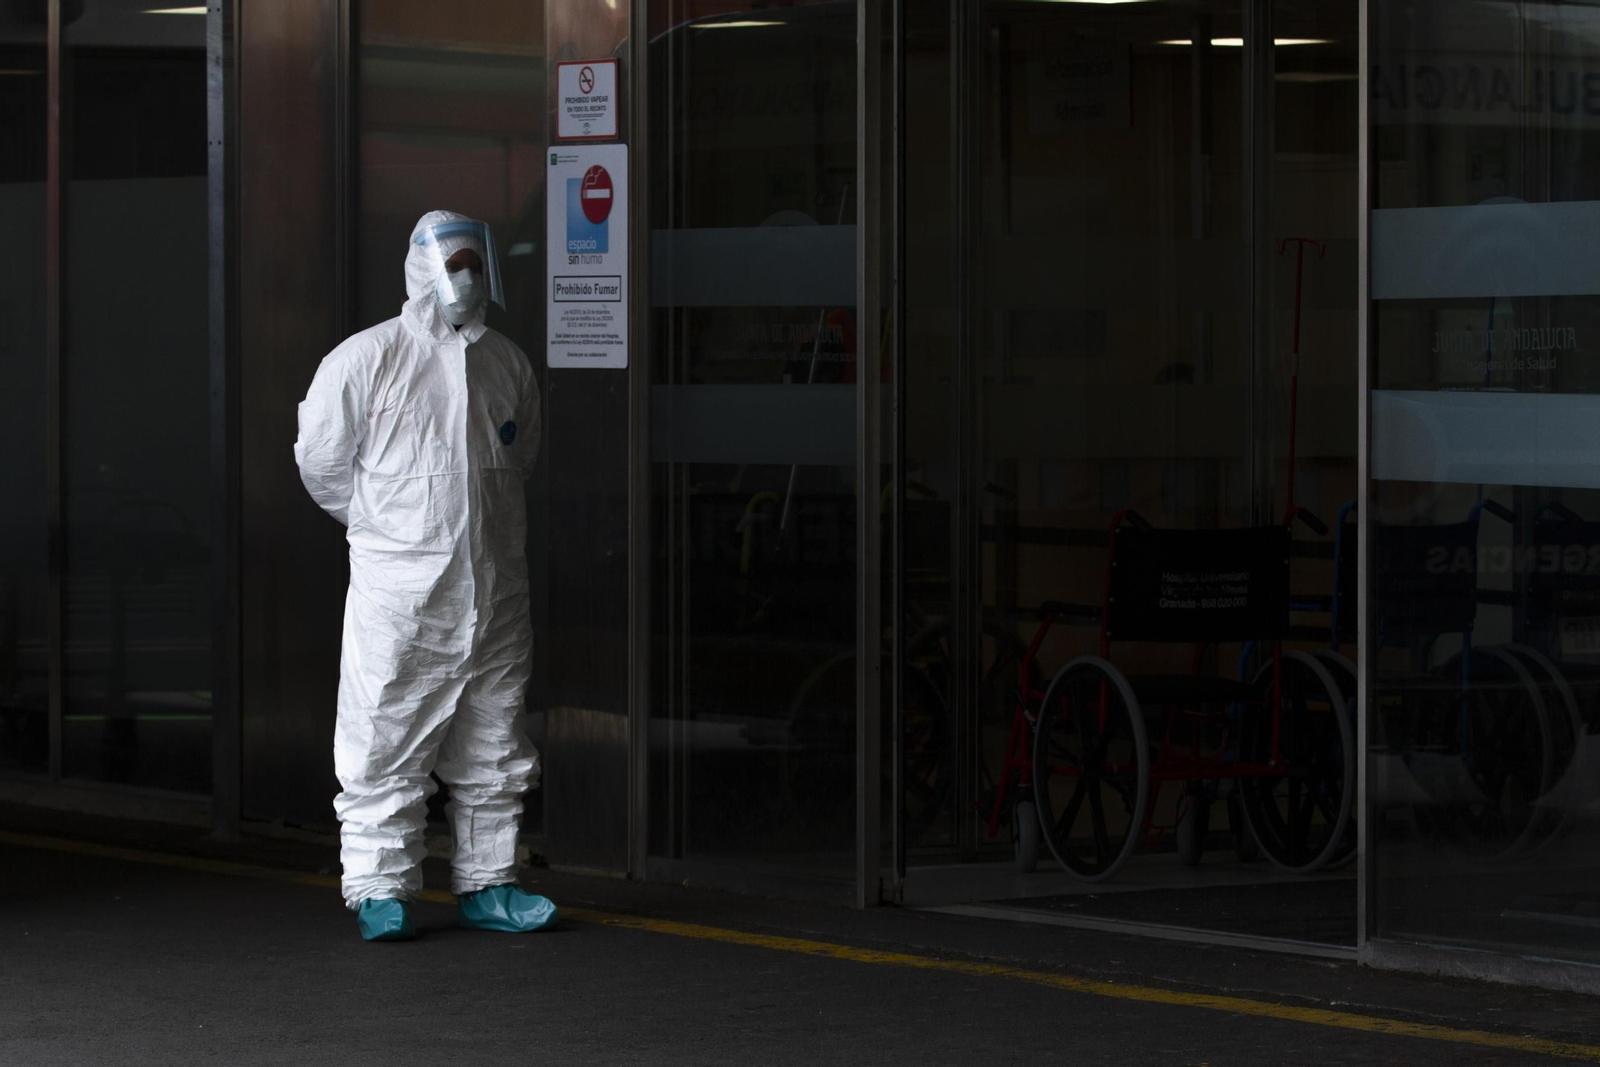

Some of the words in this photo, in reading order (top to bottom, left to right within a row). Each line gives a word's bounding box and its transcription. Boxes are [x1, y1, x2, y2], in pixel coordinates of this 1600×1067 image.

[565, 96, 590, 104] PROHIBIDO
[590, 95, 608, 103] VAPEAR
[568, 236, 597, 252] espacio
[568, 252, 580, 265] sin
[580, 254, 603, 265] humo
[556, 283, 592, 295] Prohibido
[594, 283, 618, 295] Fumar
[1432, 330, 1474, 353] JUNTA
[1480, 329, 1496, 352] DE
[1527, 356, 1556, 370] Salud
[1161, 571, 1198, 584] Hospital
[1200, 570, 1250, 582] Universitario
[1161, 585, 1191, 598] Virgen
[1159, 597, 1196, 609] Granada
[1217, 597, 1233, 608] 020
[1233, 597, 1247, 607] 000
